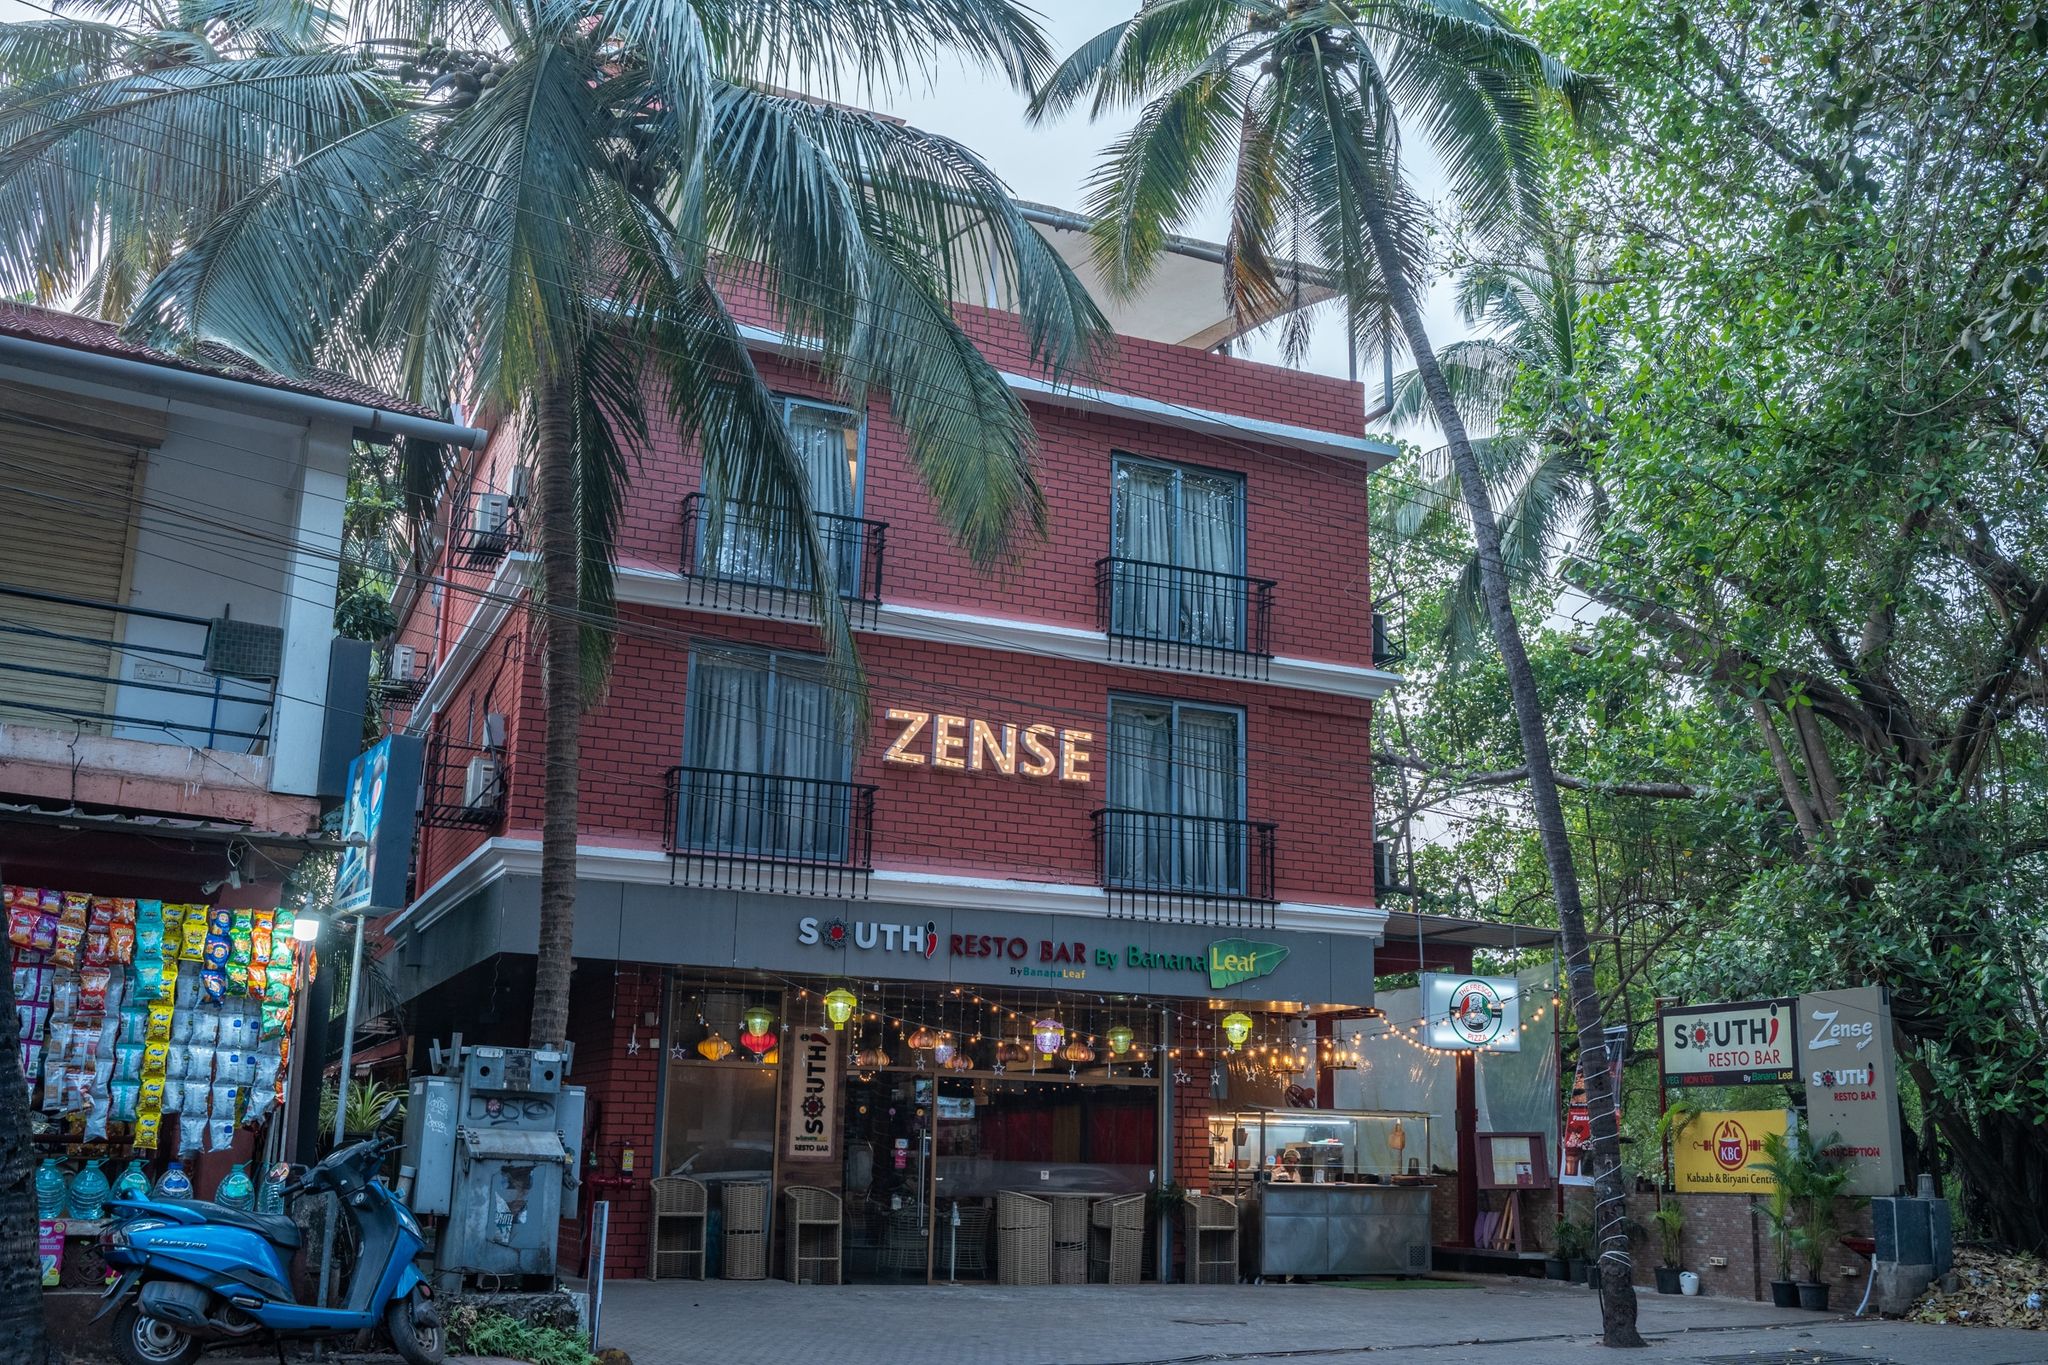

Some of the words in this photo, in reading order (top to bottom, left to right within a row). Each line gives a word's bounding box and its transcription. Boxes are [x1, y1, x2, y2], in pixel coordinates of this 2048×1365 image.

[882, 708, 1094, 783] ZENSE
[950, 933, 1029, 961] RESTO
[1040, 940, 1087, 963] BAR
[1094, 947, 1119, 970] By
[1127, 945, 1208, 972] Banana
[1211, 946, 1260, 972] Leaf
[1808, 1010, 1873, 1050] Zense
[1467, 1033, 1488, 1042] PIZZA
[1708, 1051, 1750, 1067] RESTO
[1754, 1049, 1781, 1065] BAR
[1743, 1074, 1751, 1083] By
[1752, 1072, 1777, 1080] Banana
[1834, 1091, 1859, 1101] RESTO
[1860, 1090, 1877, 1100] BAR
[794, 1144, 815, 1152] RESTO
[816, 1144, 829, 1152] BAR
[1720, 1146, 1741, 1161] KBC
[1686, 1173, 1714, 1183] Kabaab
[1715, 1174, 1722, 1183] &
[1723, 1174, 1749, 1187] Biryani
[1750, 1174, 1778, 1184] Centre
